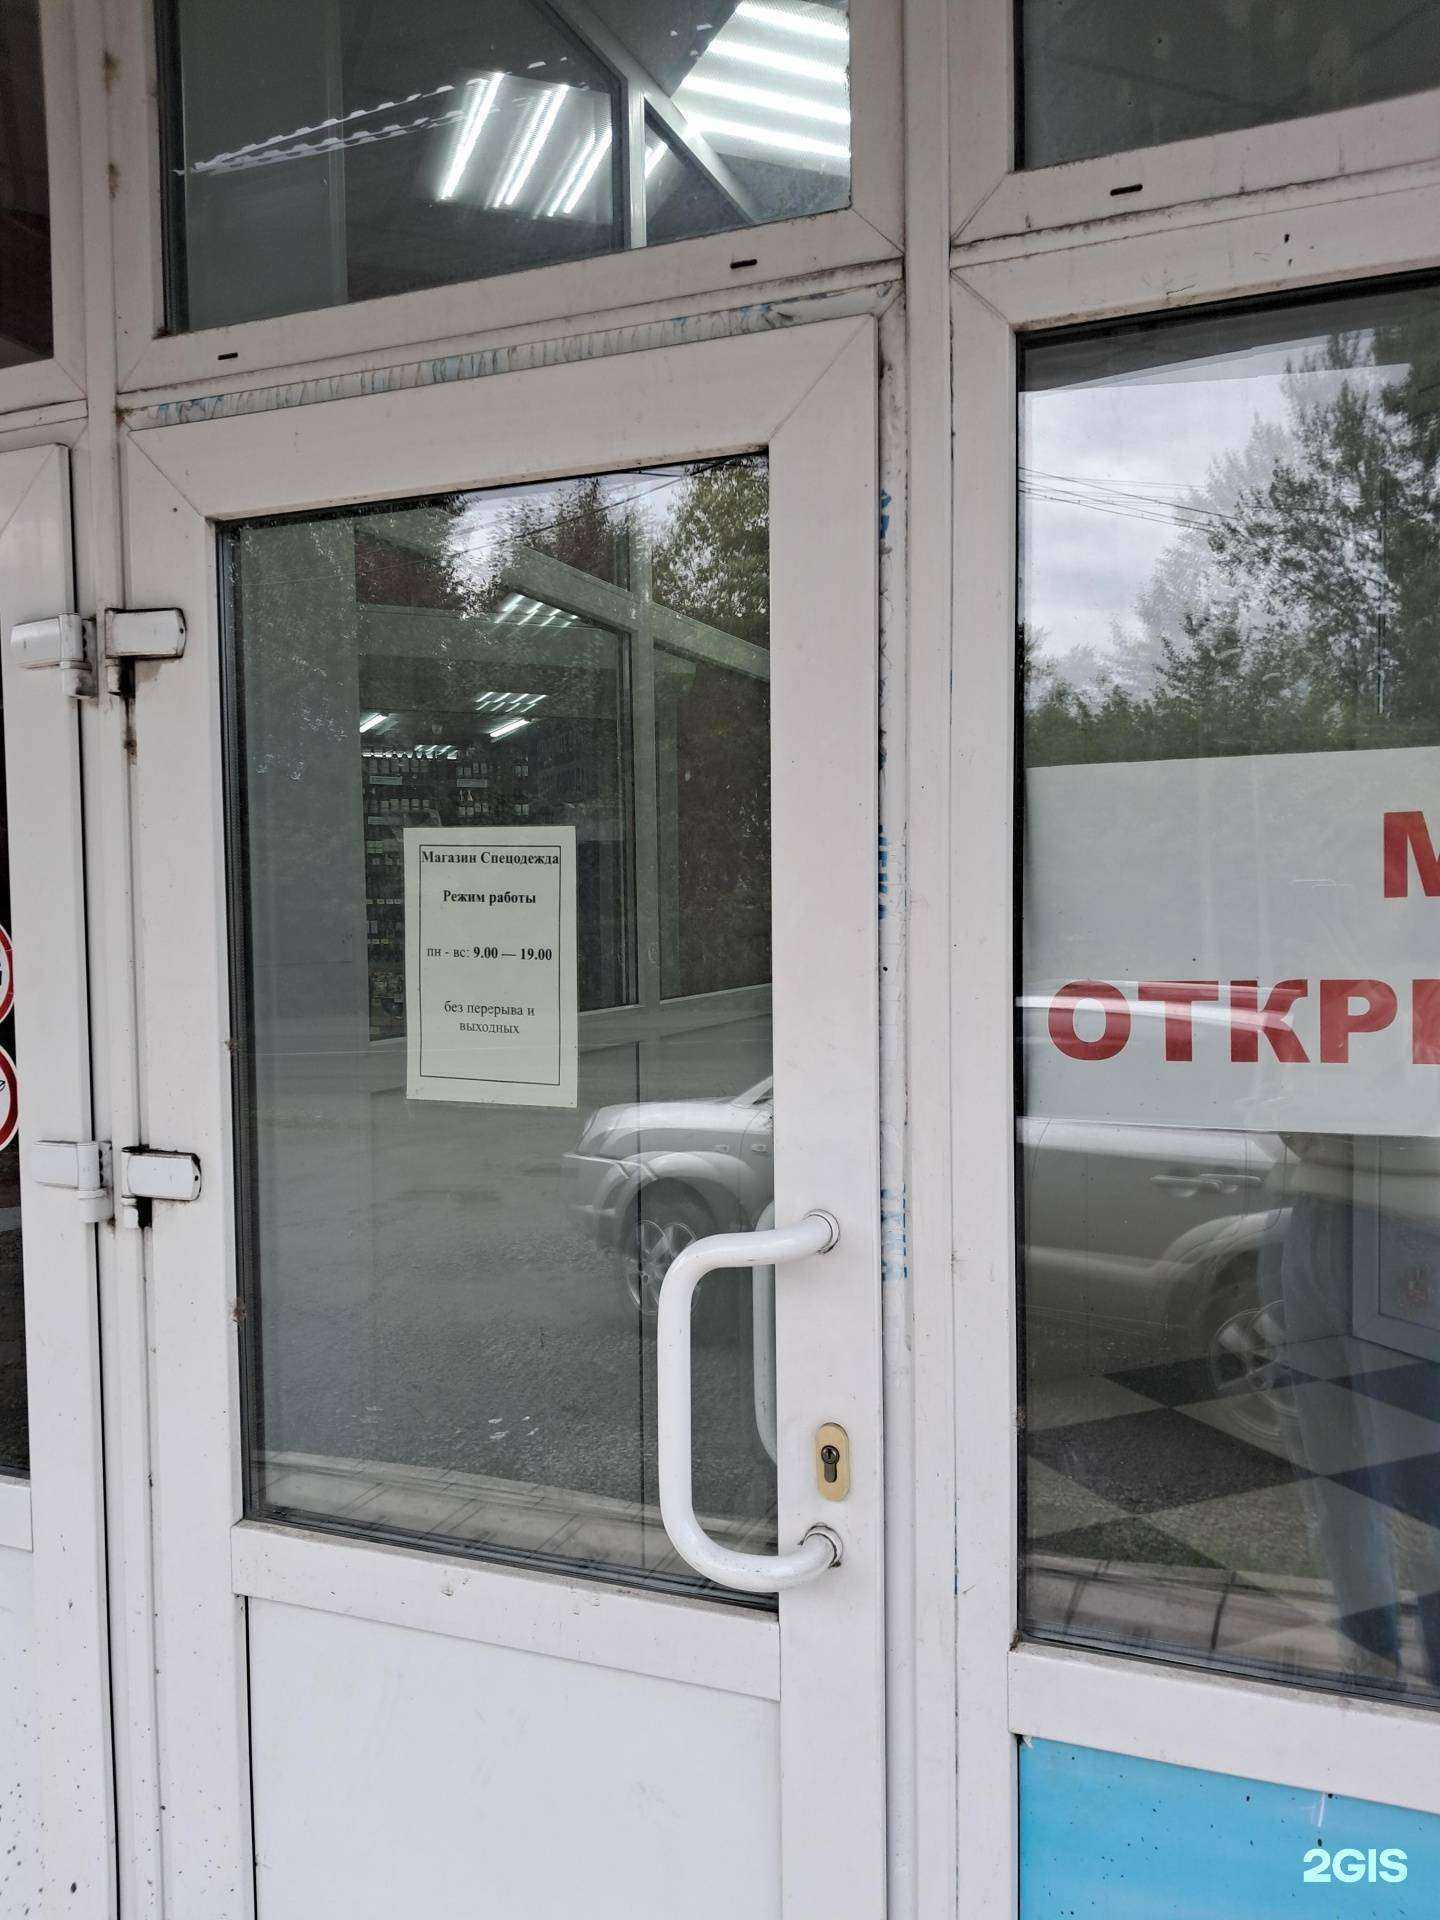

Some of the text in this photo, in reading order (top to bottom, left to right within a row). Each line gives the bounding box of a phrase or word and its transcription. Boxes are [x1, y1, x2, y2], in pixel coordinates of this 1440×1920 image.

[421, 850, 559, 865] Магазин Спецодежда
[443, 889, 536, 905] Режим работы
[427, 947, 442, 957] пн
[453, 948, 470, 959] вс:
[473, 946, 499, 960] 9.00
[520, 948, 553, 962] 19.00
[444, 1000, 536, 1017] без перерыва и
[459, 1022, 520, 1034] выходных
[1047, 978, 1440, 1065] ОТКР
